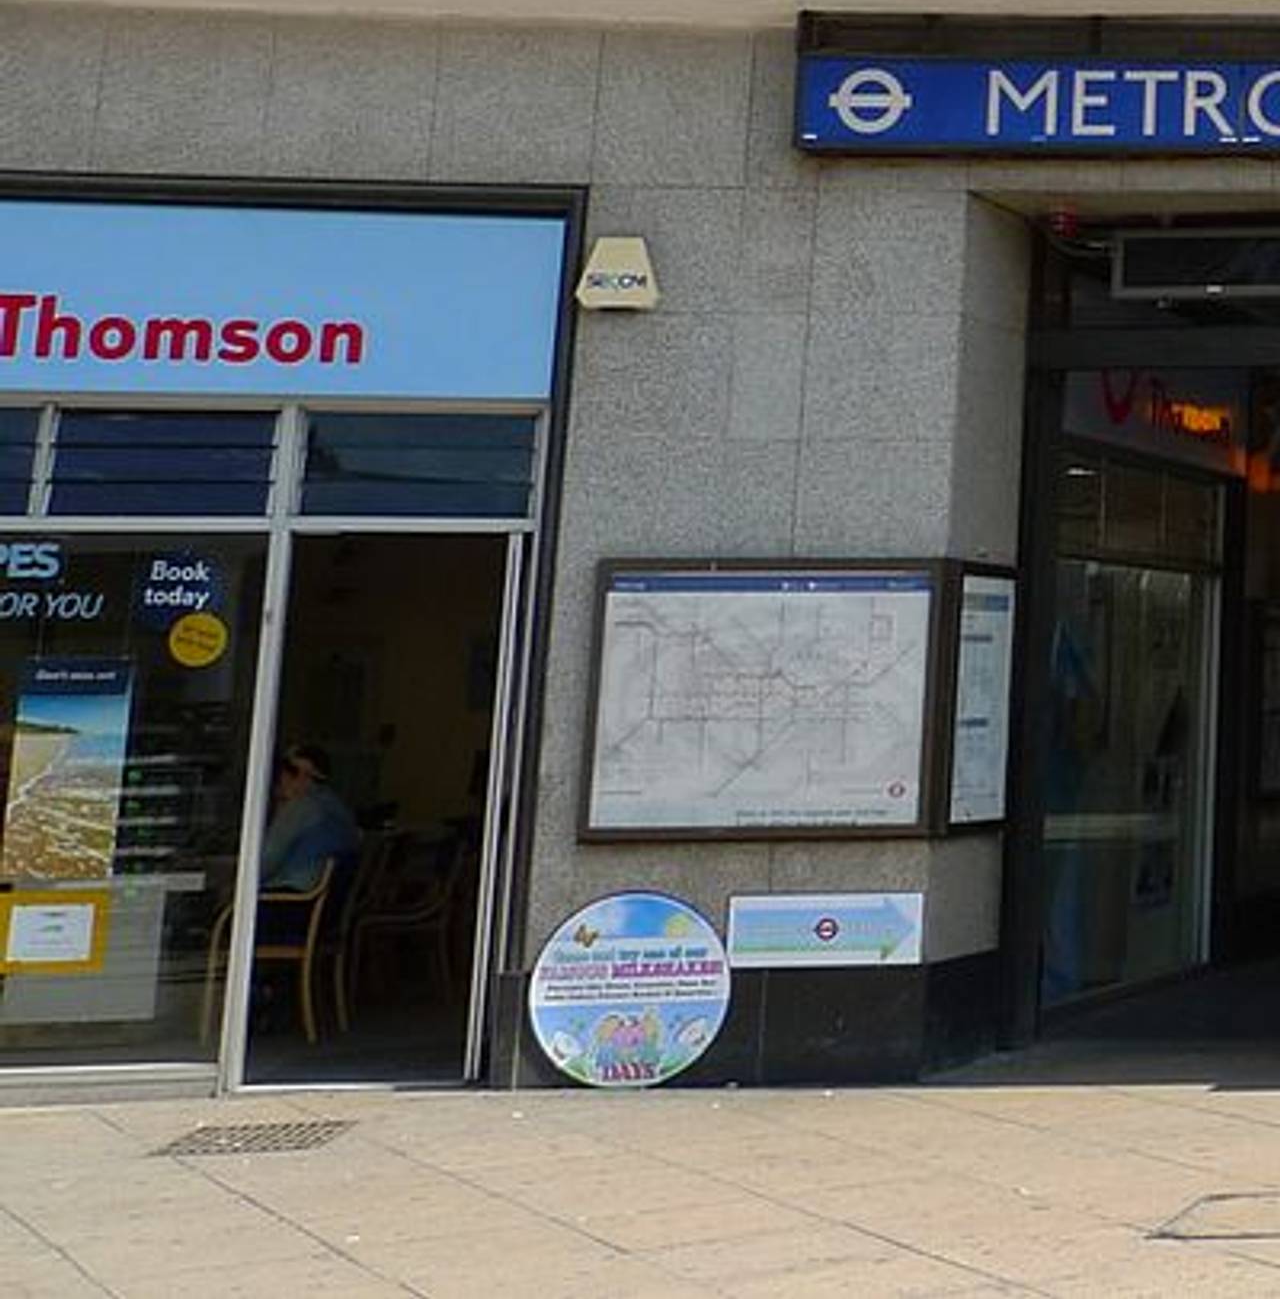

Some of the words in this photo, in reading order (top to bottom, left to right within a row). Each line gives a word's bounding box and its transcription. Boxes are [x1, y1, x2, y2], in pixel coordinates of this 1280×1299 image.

[0, 294, 364, 363] Thomson
[151, 560, 210, 582] Book
[46, 592, 104, 619] YOU
[143, 586, 210, 610] today
